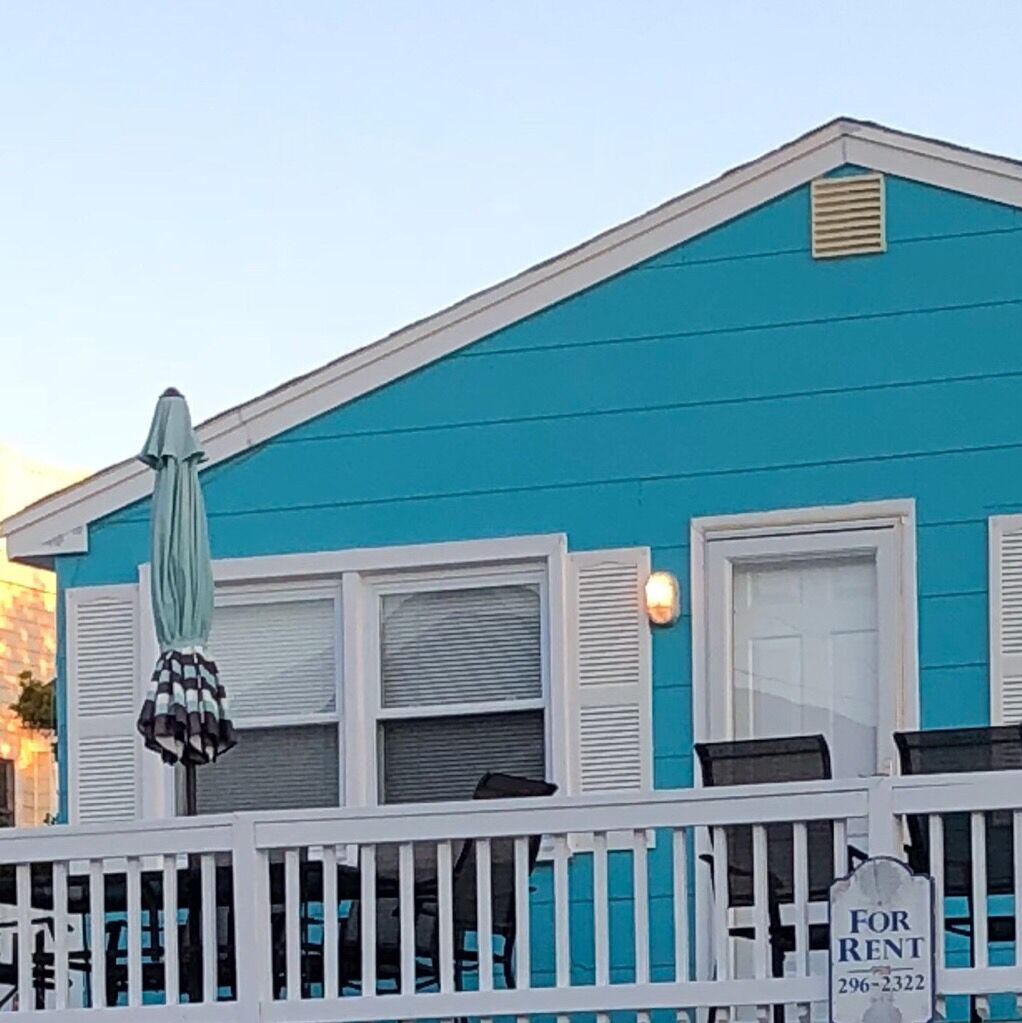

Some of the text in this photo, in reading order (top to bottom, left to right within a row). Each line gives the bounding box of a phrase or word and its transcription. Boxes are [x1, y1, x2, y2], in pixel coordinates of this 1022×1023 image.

[850, 909, 911, 933] FOR
[838, 937, 925, 962] RENT
[838, 974, 925, 994] 296-2322
